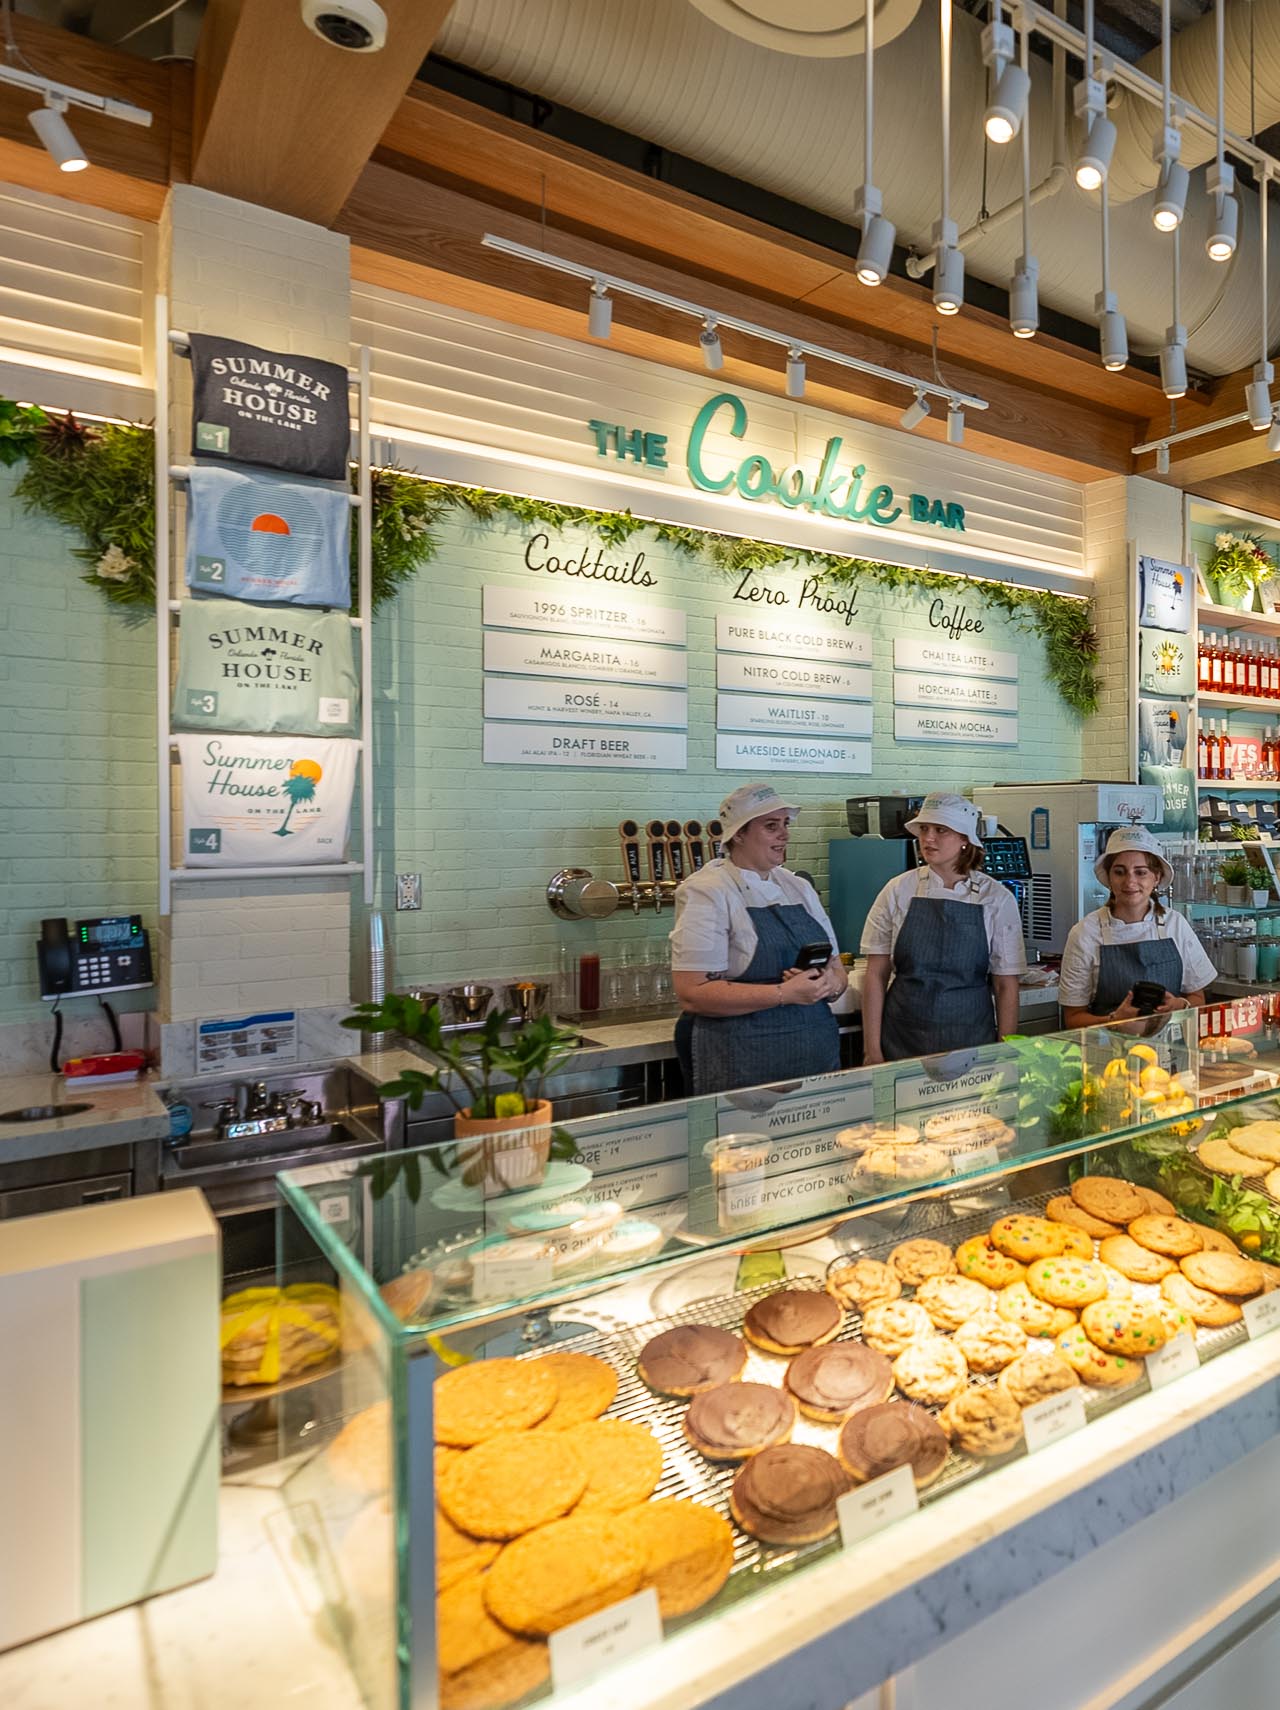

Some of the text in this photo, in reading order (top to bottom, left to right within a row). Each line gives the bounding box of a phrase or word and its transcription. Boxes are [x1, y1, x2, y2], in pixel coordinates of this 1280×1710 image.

[211, 357, 331, 401] SUMMER
[223, 388, 317, 425] HOUSE
[238, 410, 302, 431] ON THE LAKE
[215, 431, 224, 449] 1
[588, 393, 966, 533] THE Cookie BAR
[524, 533, 659, 589] Cocktails
[211, 562, 223, 580] 2
[732, 568, 859, 625] Zero Proof
[534, 602, 566, 616] 1996
[570, 606, 627, 623] SPRITZER
[928, 598, 985, 641] Coffee
[208, 626, 323, 656] SUMMER
[728, 626, 755, 639] PURE
[758, 630, 791, 643] BLACK
[794, 634, 823, 647] COLD
[827, 638, 854, 650] BREW
[540, 648, 621, 666] MARGARITA
[922, 650, 944, 661] CHAI
[947, 653, 961, 662] TEA
[964, 656, 987, 666] LATTE
[221, 663, 312, 683] HOUSE
[744, 667, 778, 679] NITRO
[781, 670, 810, 682] COLD
[814, 674, 841, 684] BREW
[565, 693, 600, 707] ROSÉ
[918, 684, 965, 696] HORCHATA
[968, 689, 990, 699] LATTE
[202, 695, 215, 713] 3
[768, 708, 816, 720] WAITLIST
[917, 719, 957, 730] MEXICAN
[960, 722, 991, 733] MOCHA
[552, 737, 629, 752] DRAFT BEER
[736, 744, 786, 757] LAKESIDE
[789, 747, 846, 760] LEMONADE
[1231, 744, 1257, 763] YES
[203, 740, 295, 770] Summer
[207, 769, 281, 797] House
[1162, 782, 1189, 796] UMMER
[1163, 798, 1187, 810] OUSE
[205, 833, 218, 850] 4
